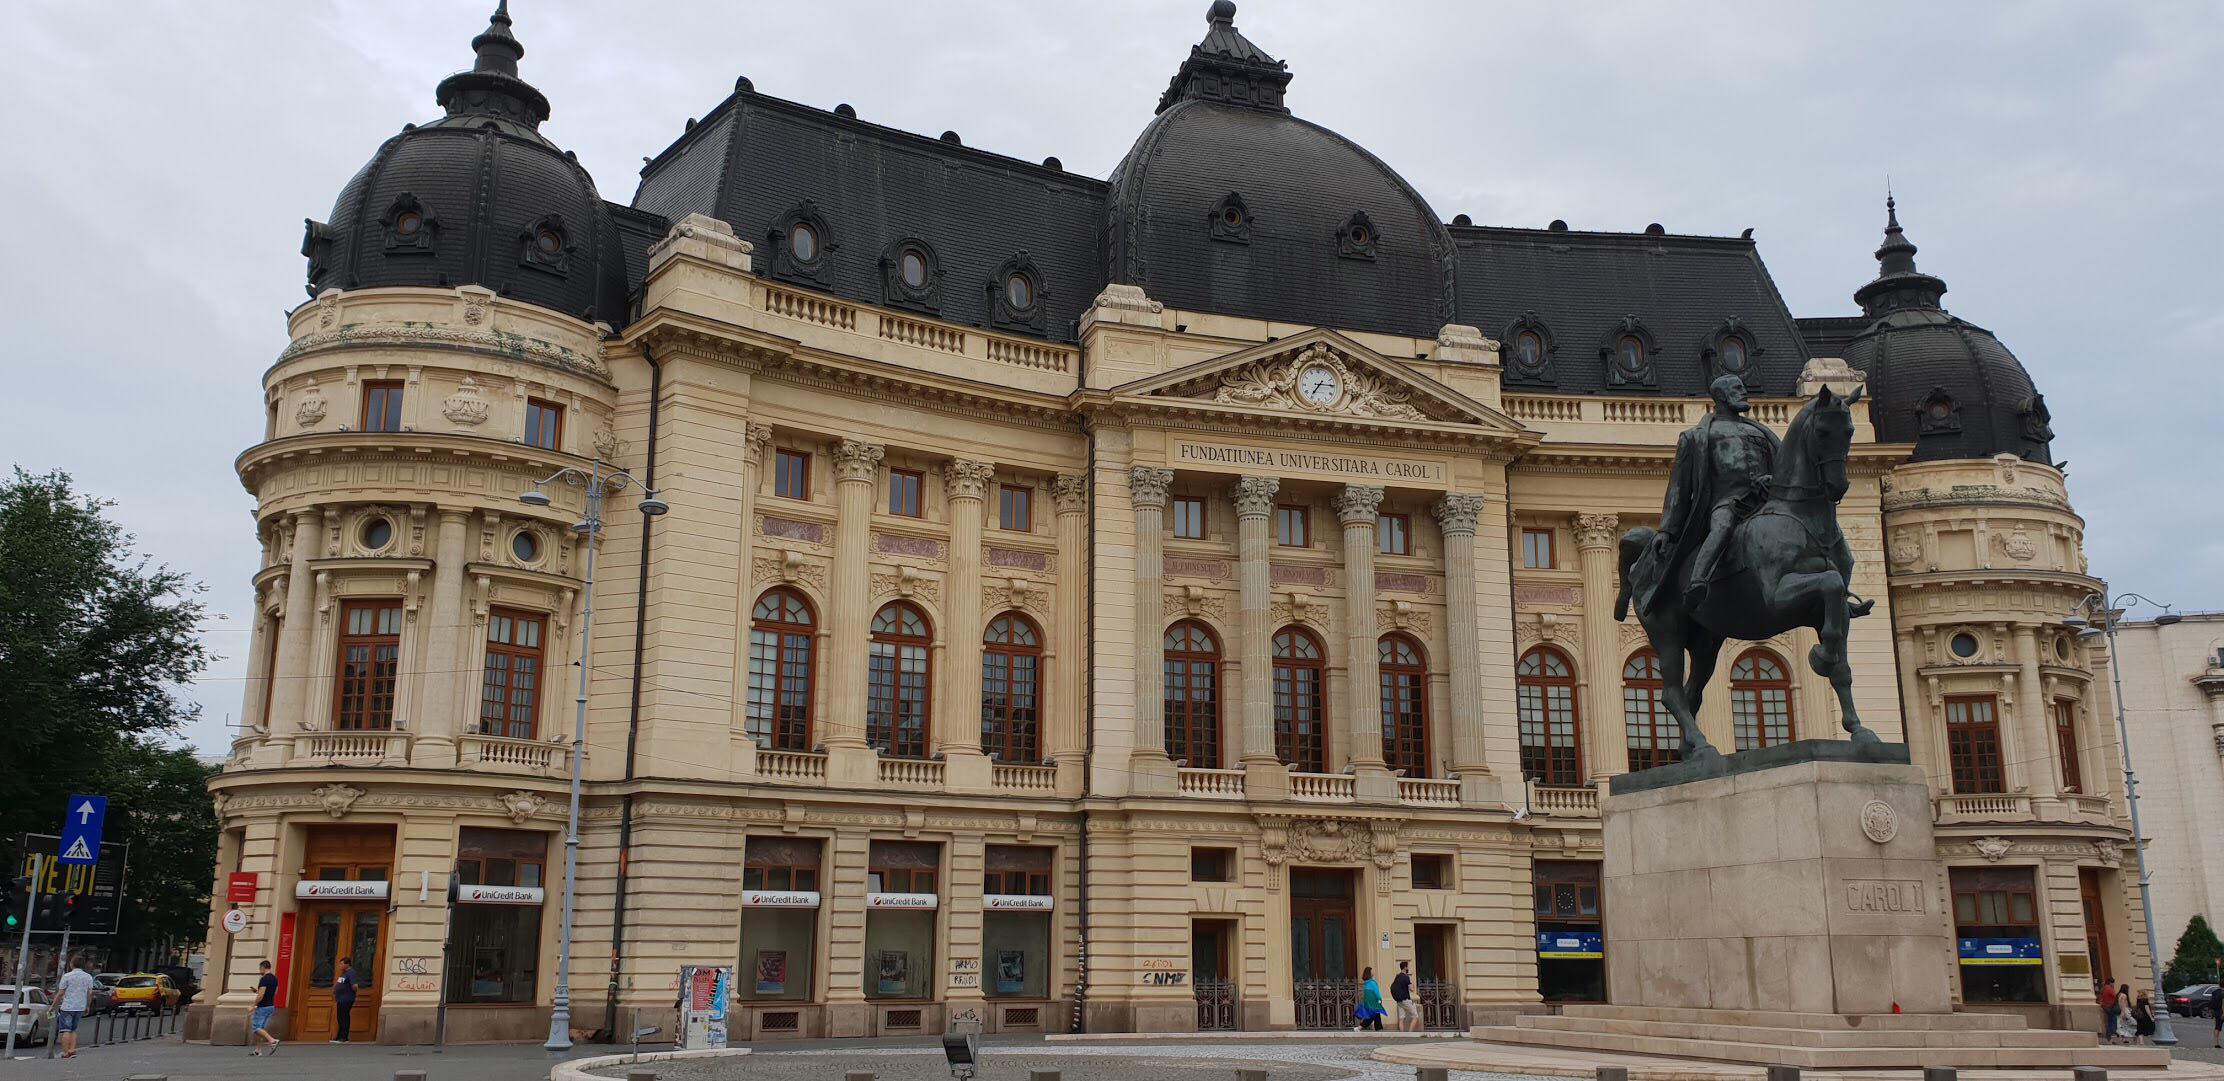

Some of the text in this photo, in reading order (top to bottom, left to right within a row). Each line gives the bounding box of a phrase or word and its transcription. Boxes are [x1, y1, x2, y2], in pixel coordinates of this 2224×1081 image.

[1181, 444, 1274, 466] FUNDATIUNEA
[1280, 453, 1379, 475] UNIVERSITARA
[1385, 462, 1430, 479] CAROL
[319, 885, 375, 895] UniCredit Bank
[481, 890, 533, 900] UniCredit Bank
[761, 895, 809, 904] UniCredit Bank
[882, 897, 911, 905] UniCredit
[1846, 883, 1911, 912] CAROL
[1000, 899, 1044, 907] UniCredit Bank
